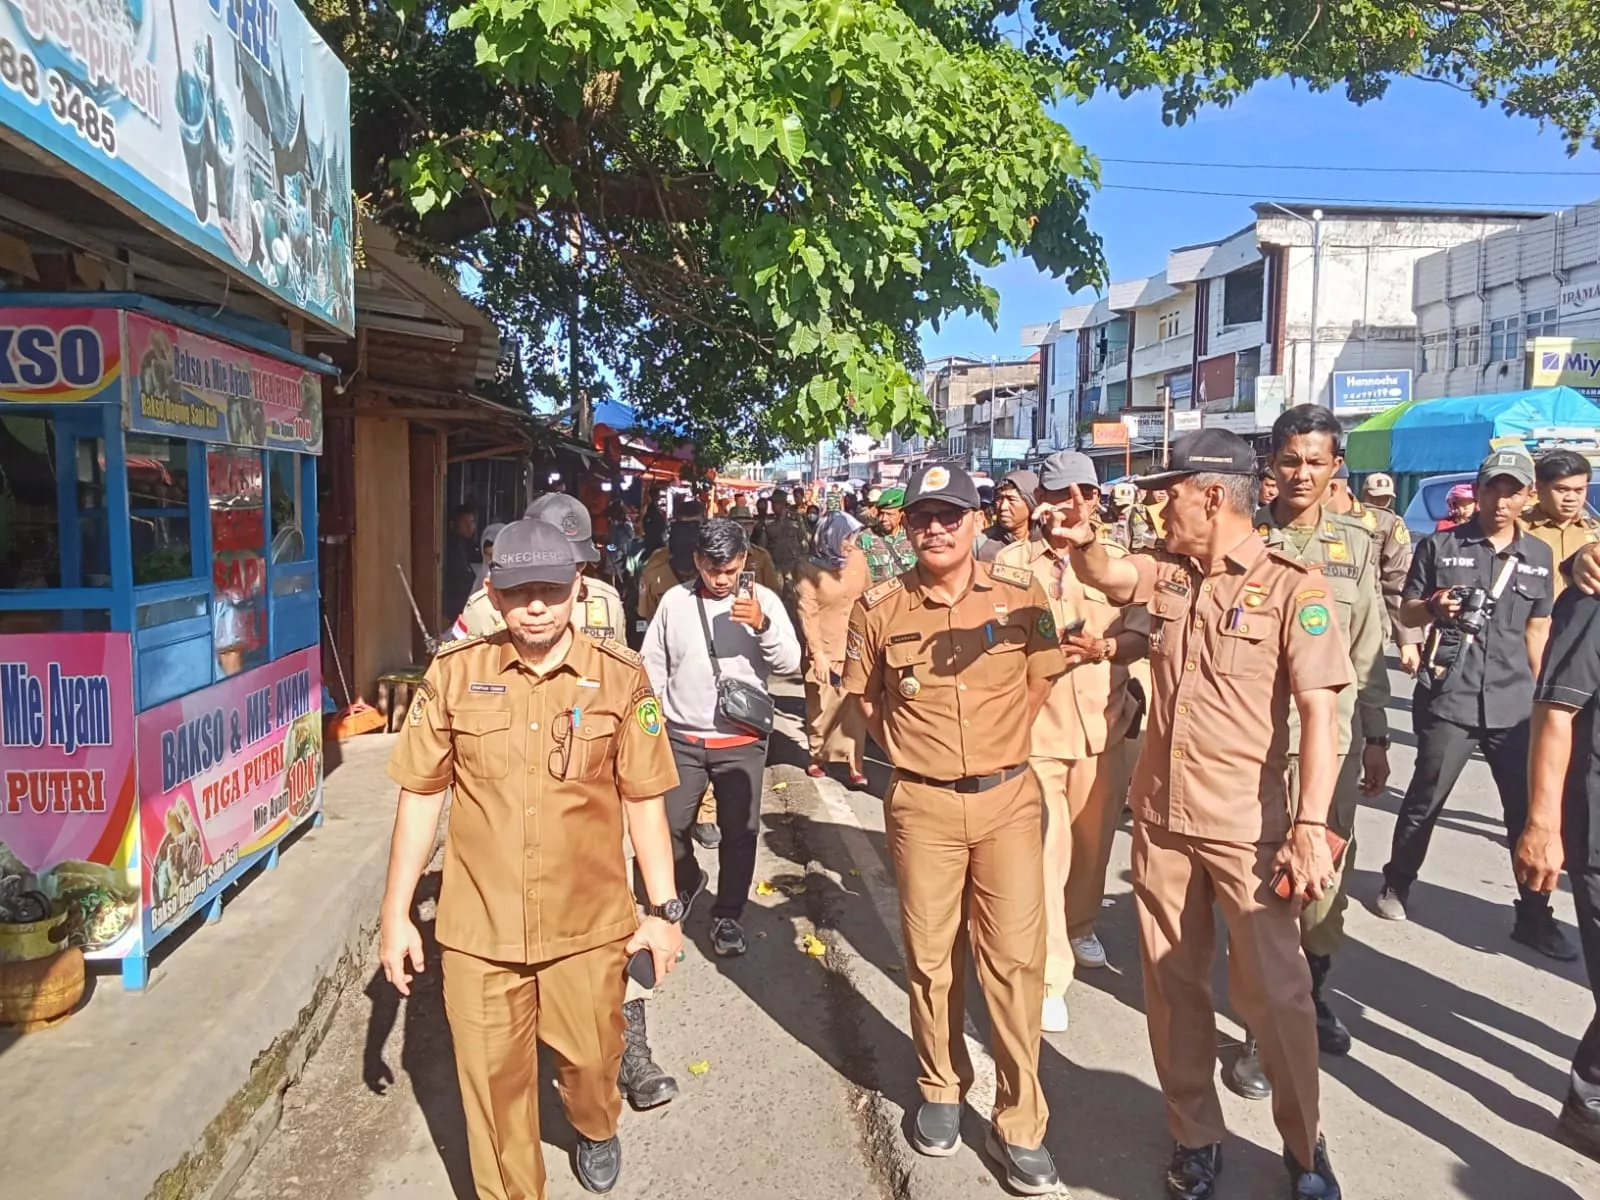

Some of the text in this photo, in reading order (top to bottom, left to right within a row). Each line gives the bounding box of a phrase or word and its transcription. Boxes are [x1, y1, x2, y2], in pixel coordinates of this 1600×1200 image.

[48, 73, 117, 155] 3485
[118, 42, 161, 126] Asli
[174, 347, 202, 387] Bakso
[204, 362, 210, 386] &
[0, 663, 110, 754] Mie Ayam
[162, 670, 310, 792] BAKSO & MIE AYAM
[6, 771, 105, 812] PUTRI
[202, 742, 284, 820] TIGA PUTRI
[253, 804, 268, 832] Mie
[269, 790, 289, 820] Ayam
[152, 895, 177, 932] Bakso
[178, 873, 207, 908] Daging
